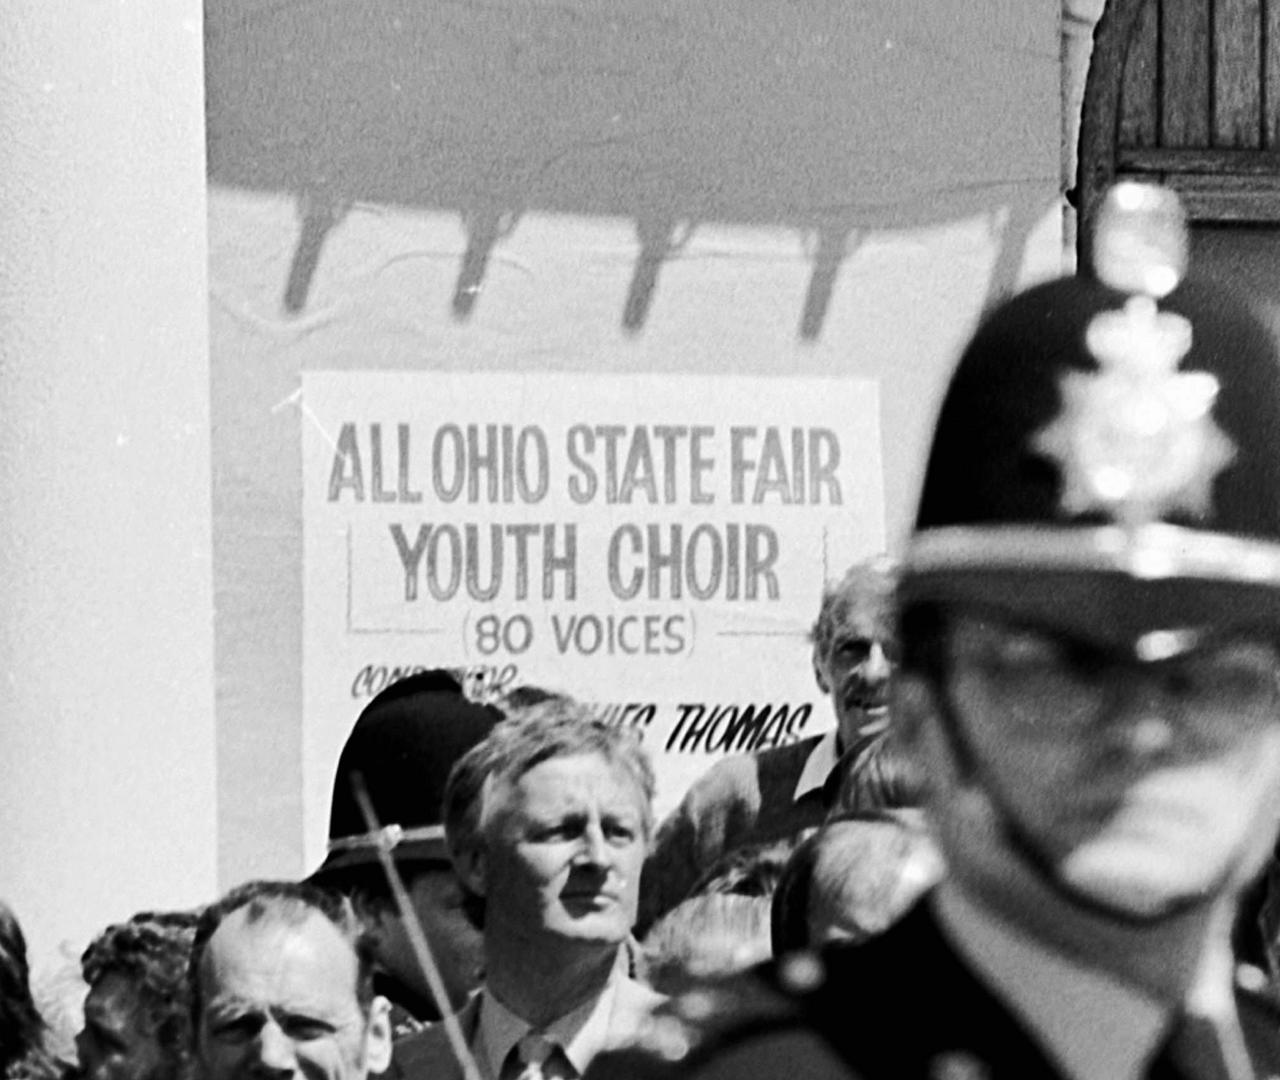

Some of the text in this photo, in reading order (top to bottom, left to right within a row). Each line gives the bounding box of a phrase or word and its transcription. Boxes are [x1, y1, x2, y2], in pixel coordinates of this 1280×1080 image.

[326, 422, 844, 505] ALL OHIO STATE FAIR
[389, 522, 781, 602] YOUTH CHOIR
[462, 609, 697, 658] (80 VOICES)
[665, 702, 813, 754] THOMAS
